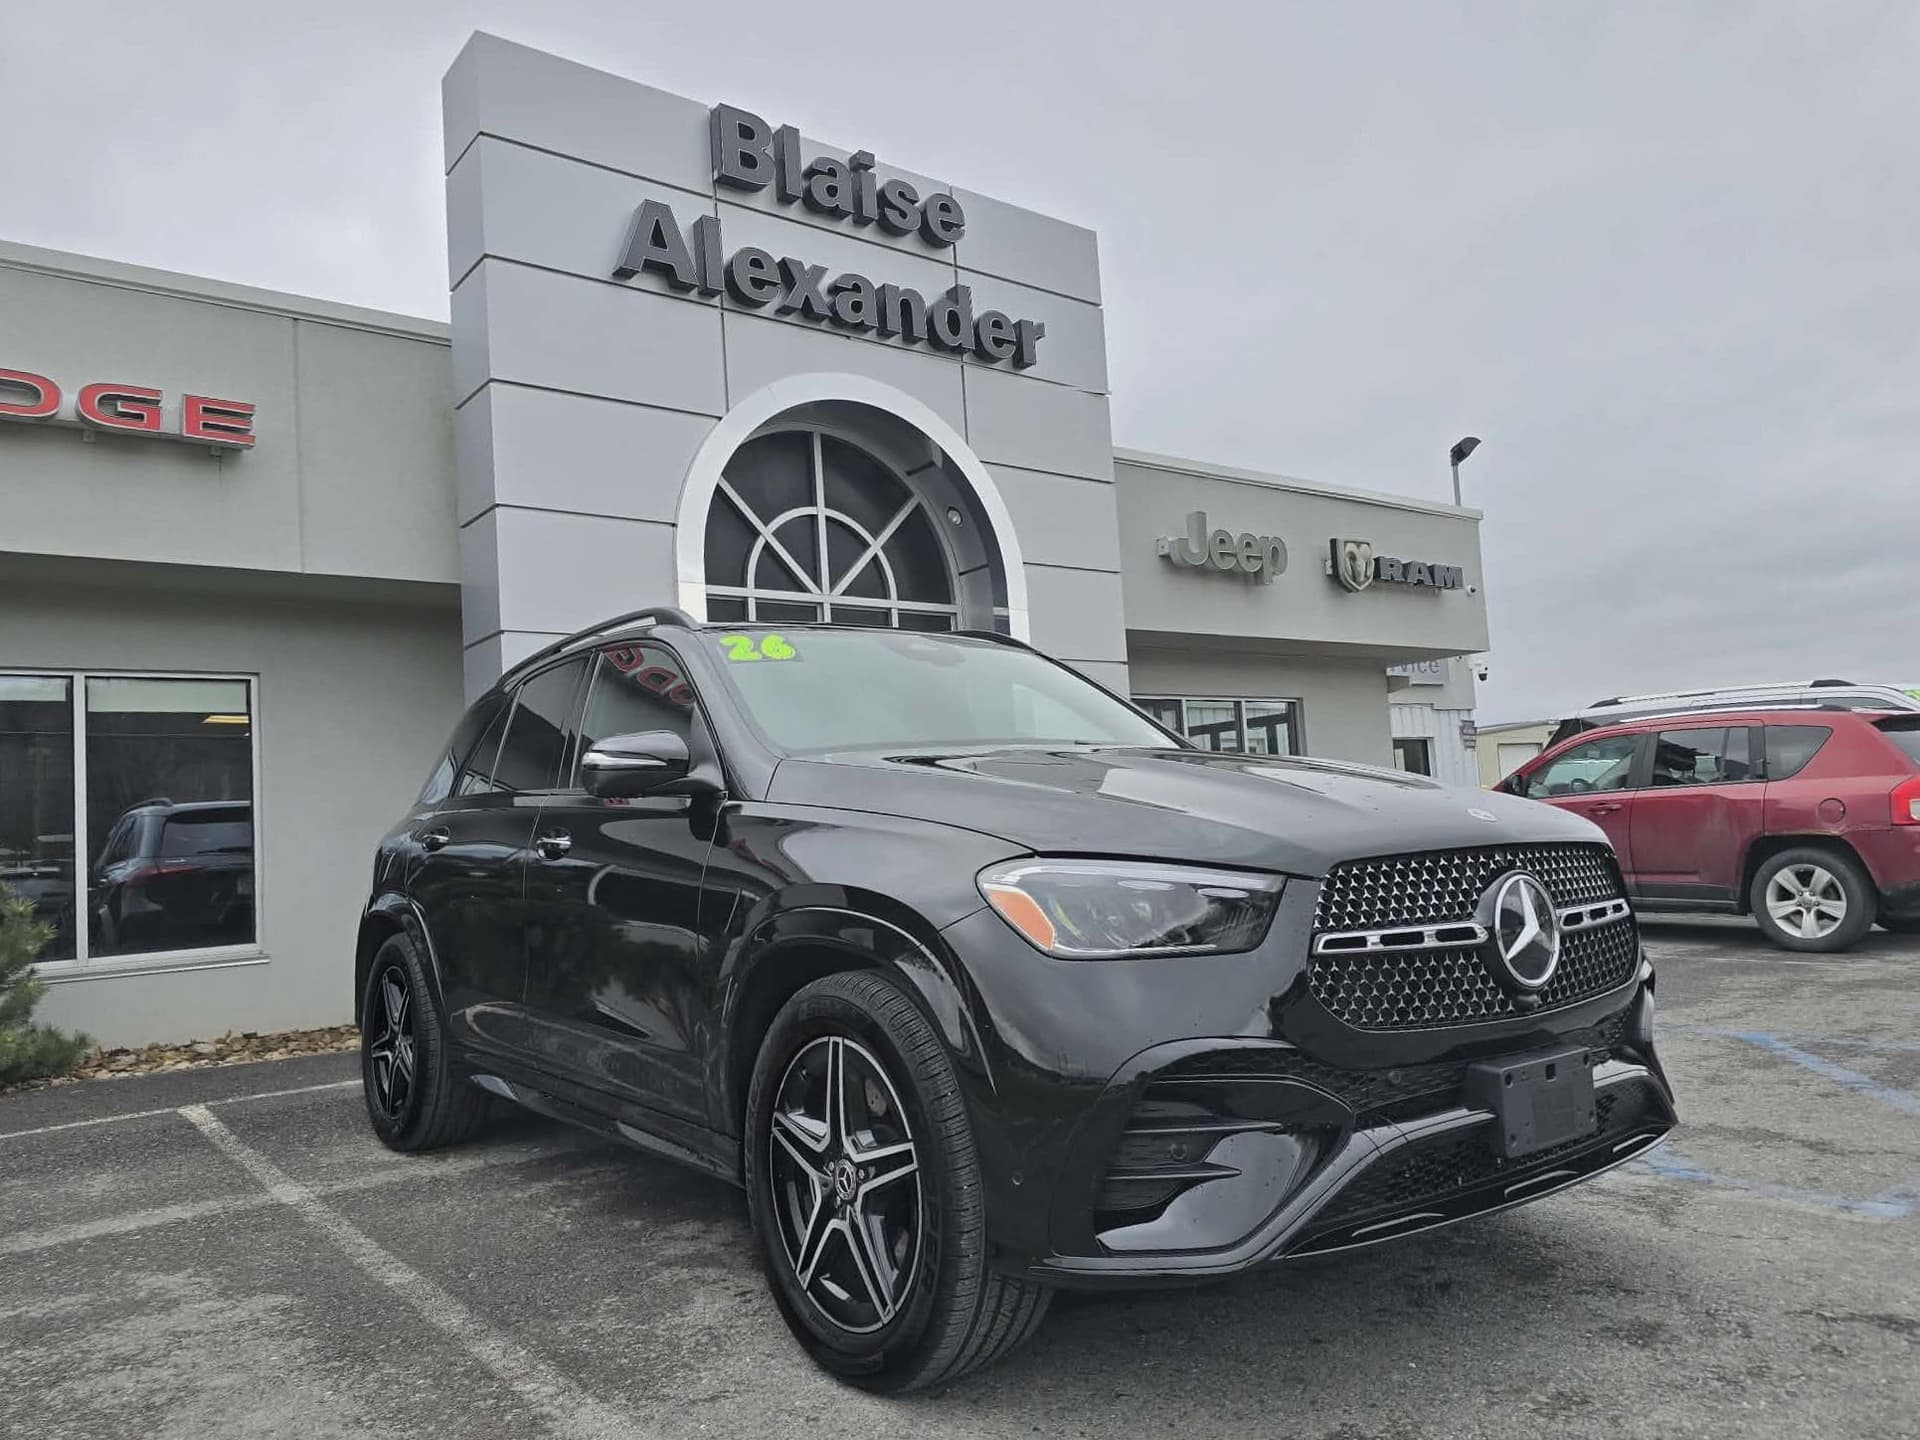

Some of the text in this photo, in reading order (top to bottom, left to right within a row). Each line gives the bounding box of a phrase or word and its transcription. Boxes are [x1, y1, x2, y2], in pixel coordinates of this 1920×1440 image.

[710, 102, 967, 248] Blaise
[612, 198, 1046, 369] Alexander
[1166, 511, 1288, 585] Jeep
[1374, 556, 1464, 590] RAM
[719, 633, 796, 662] 26
